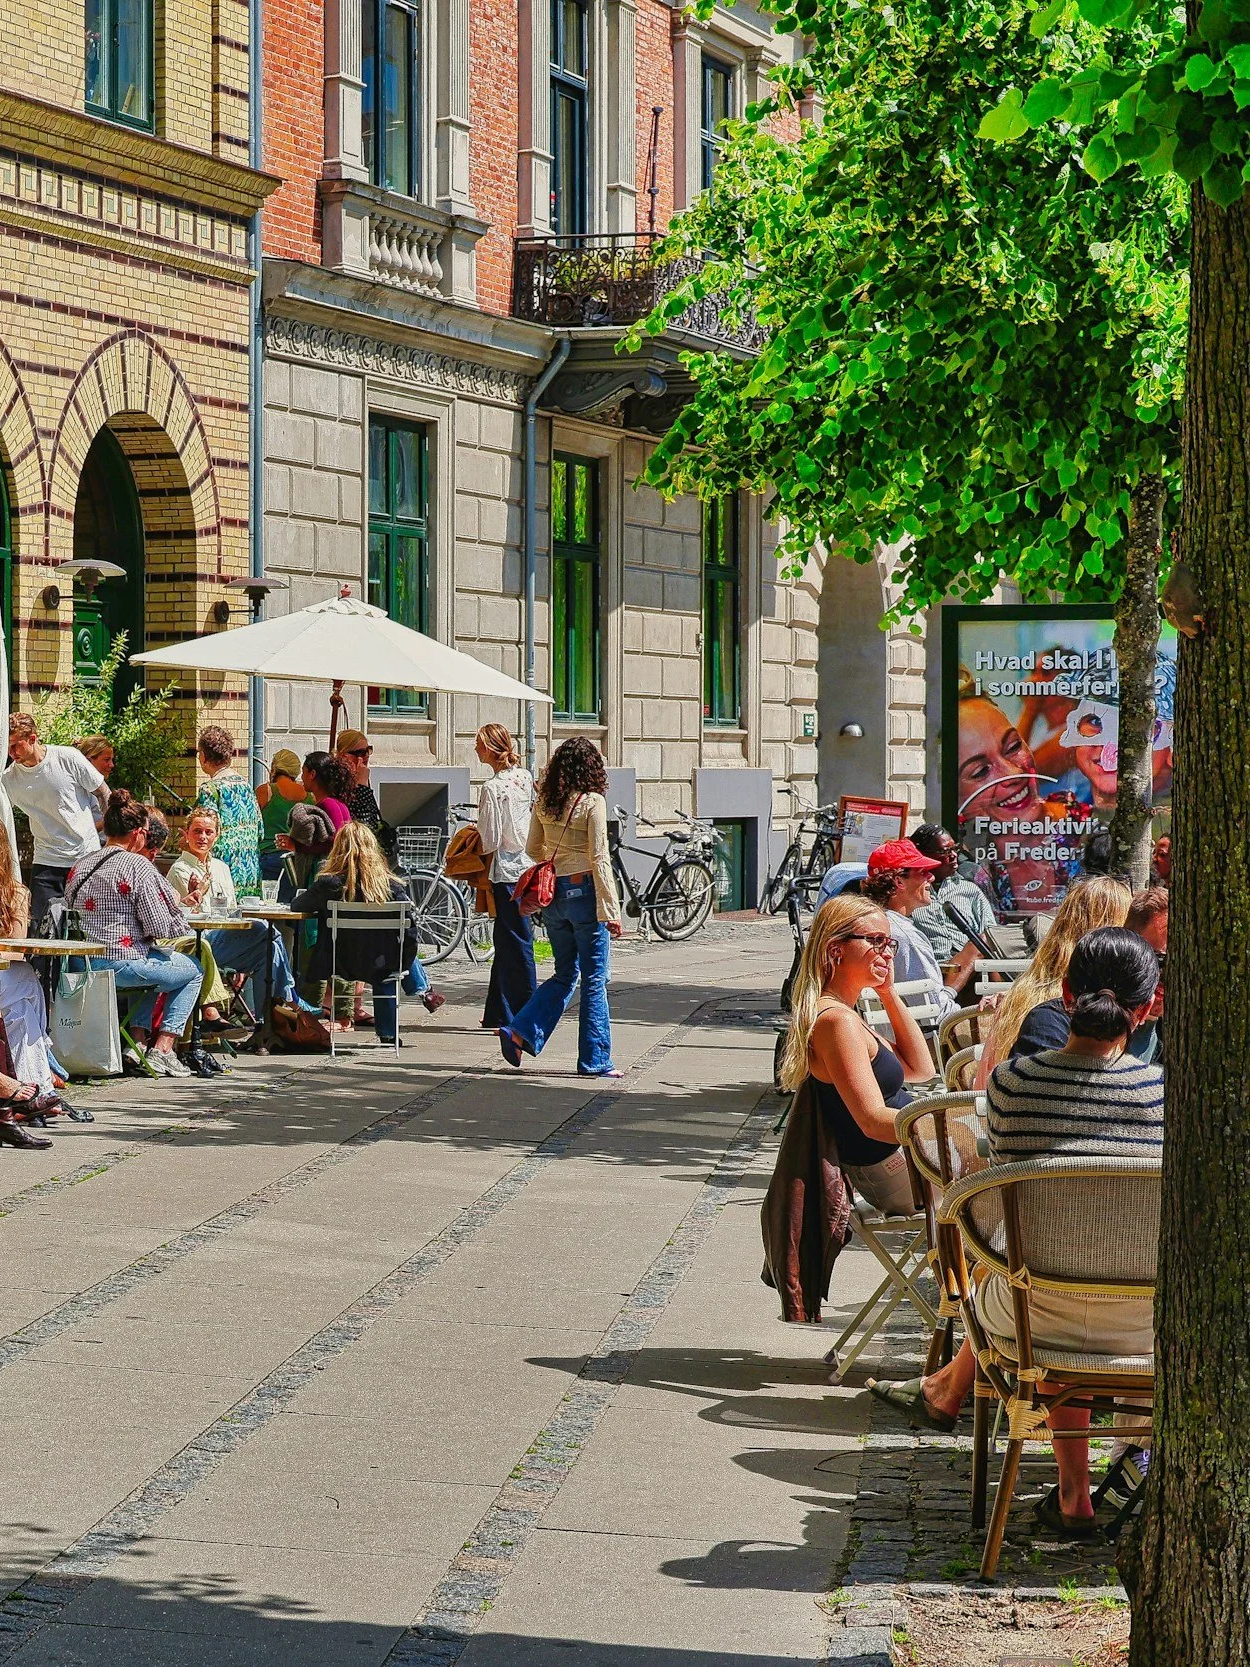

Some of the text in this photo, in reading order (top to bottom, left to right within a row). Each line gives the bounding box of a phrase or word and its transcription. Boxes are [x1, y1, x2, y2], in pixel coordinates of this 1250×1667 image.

[975, 650, 1035, 670] Hvad
[1041, 650, 1089, 670] skal
[1096, 649, 1103, 669] I
[975, 677, 982, 697] i
[974, 841, 998, 864] på
